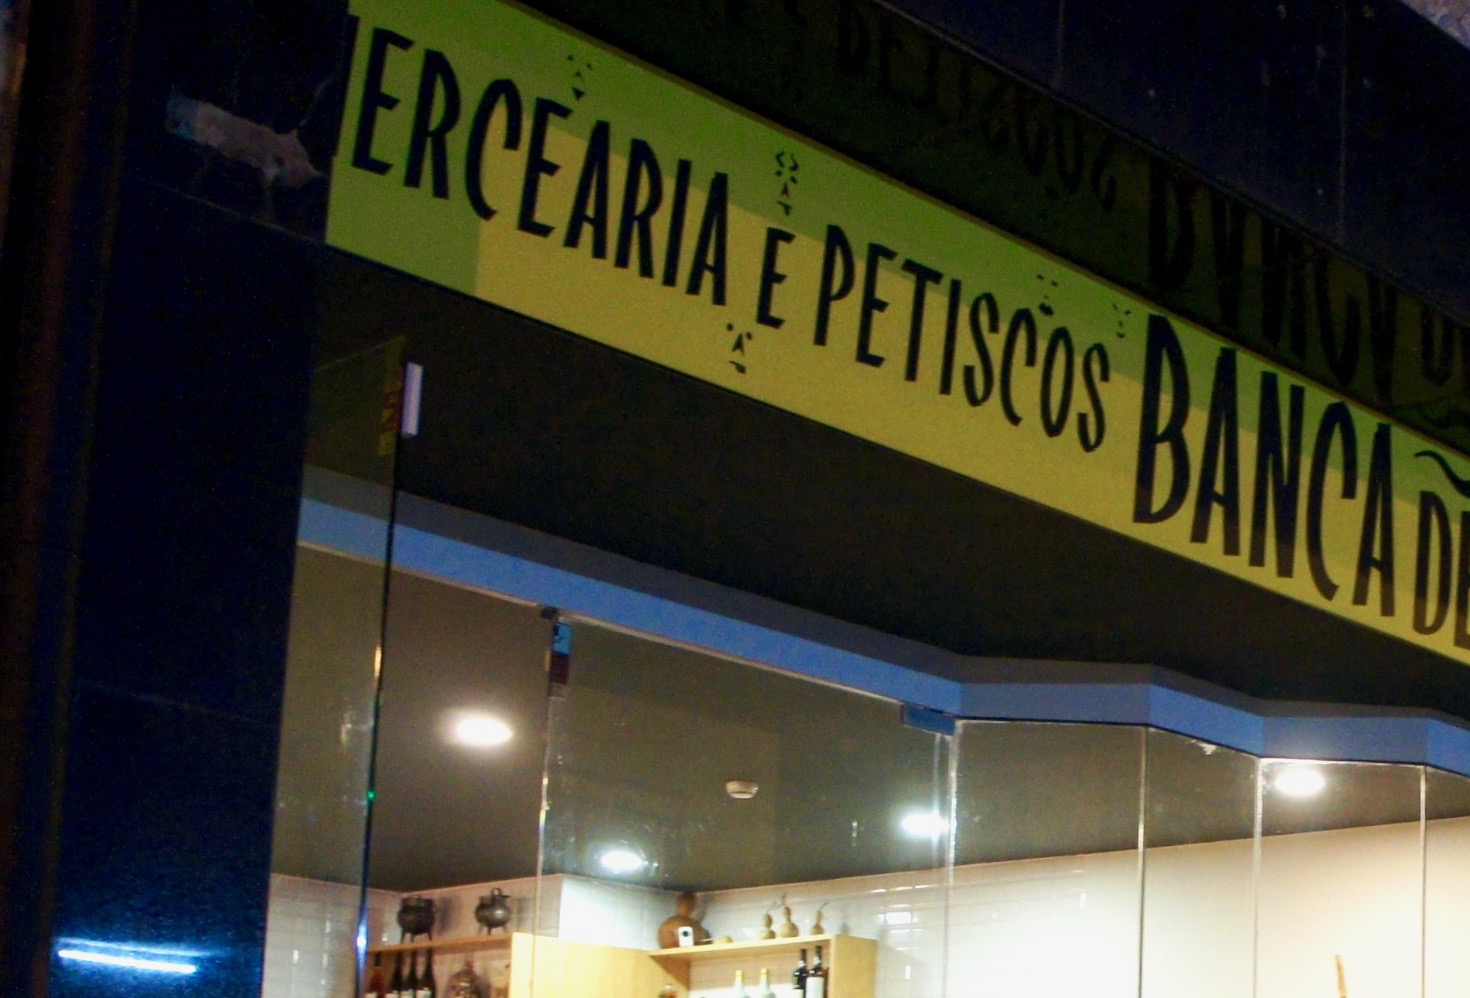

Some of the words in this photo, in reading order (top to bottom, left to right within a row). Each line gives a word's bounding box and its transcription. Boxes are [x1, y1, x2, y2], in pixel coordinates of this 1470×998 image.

[756, 227, 796, 329] E
[813, 225, 1111, 453] PETISCOS
[1133, 313, 1396, 618] BANCA
